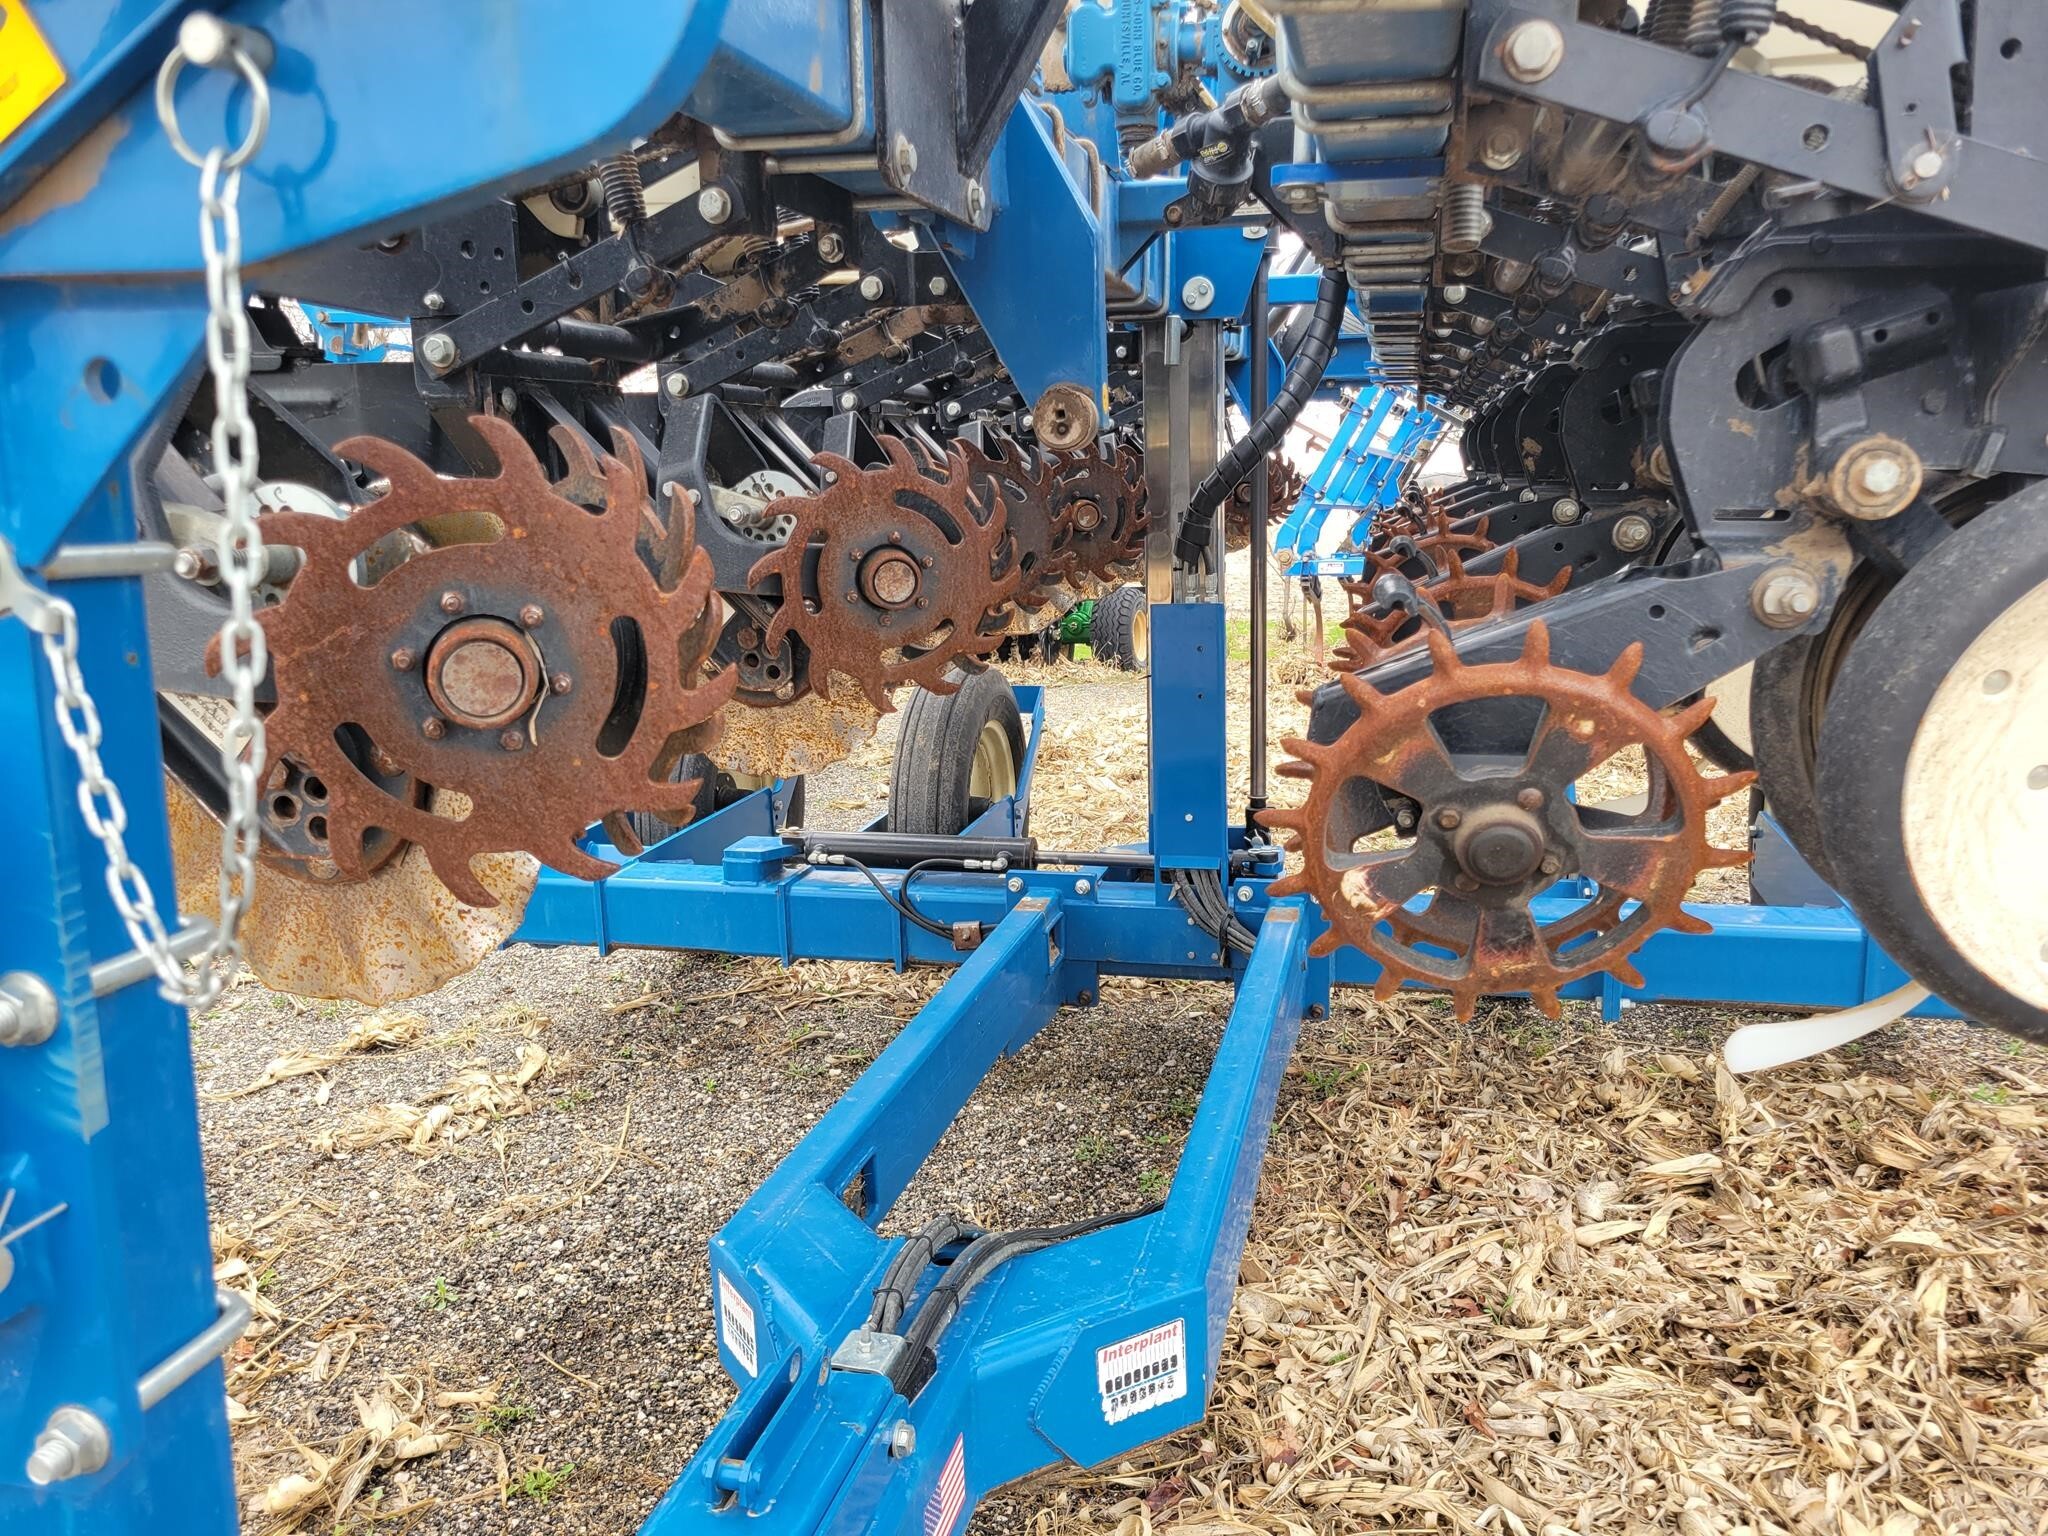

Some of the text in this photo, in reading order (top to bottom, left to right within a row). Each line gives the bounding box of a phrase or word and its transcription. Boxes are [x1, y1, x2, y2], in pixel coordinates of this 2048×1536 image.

[1133, 45, 1143, 73] BLUE
[1120, 72, 1131, 86] AL
[1132, 77, 1143, 96] CO.
[1102, 1324, 1178, 1364] Interplant
